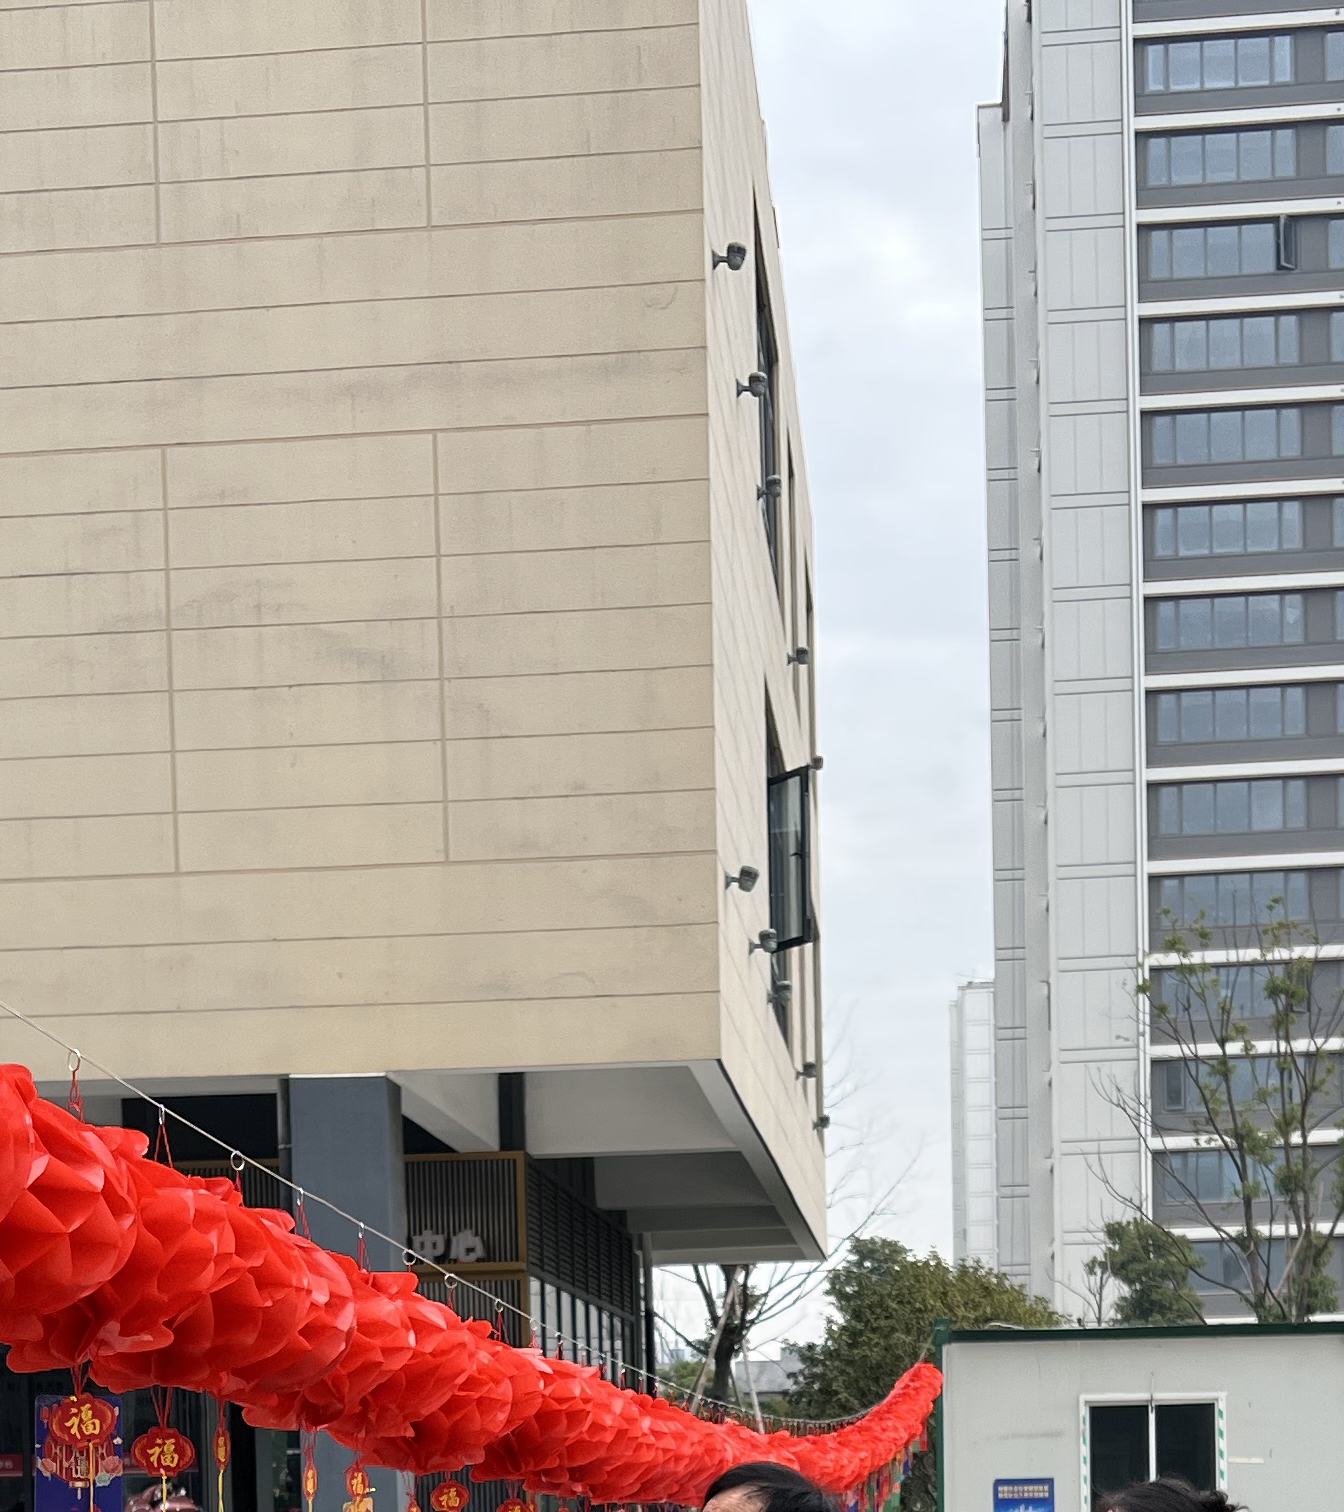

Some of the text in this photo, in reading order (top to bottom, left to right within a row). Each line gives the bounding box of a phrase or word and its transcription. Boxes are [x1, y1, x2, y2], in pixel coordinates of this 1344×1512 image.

[65, 1403, 101, 1440] 福
[147, 1438, 179, 1468] 福
[439, 1488, 460, 1508] 福
